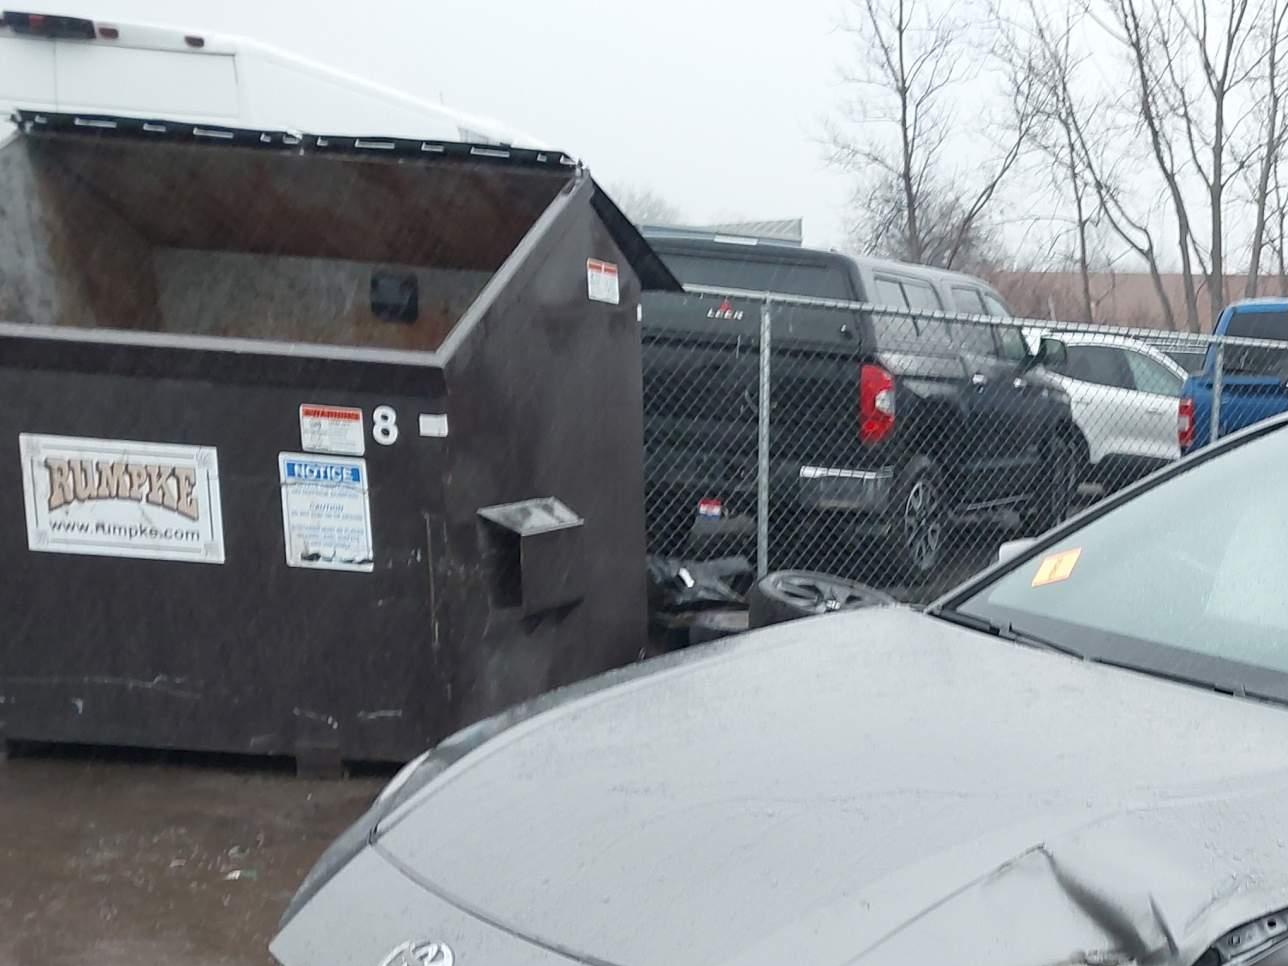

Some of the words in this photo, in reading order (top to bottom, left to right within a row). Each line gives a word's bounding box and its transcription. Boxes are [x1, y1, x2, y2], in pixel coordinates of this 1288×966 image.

[373, 405, 399, 446] 8
[45, 457, 199, 522] RUMPKE
[294, 464, 353, 483] NOTICE
